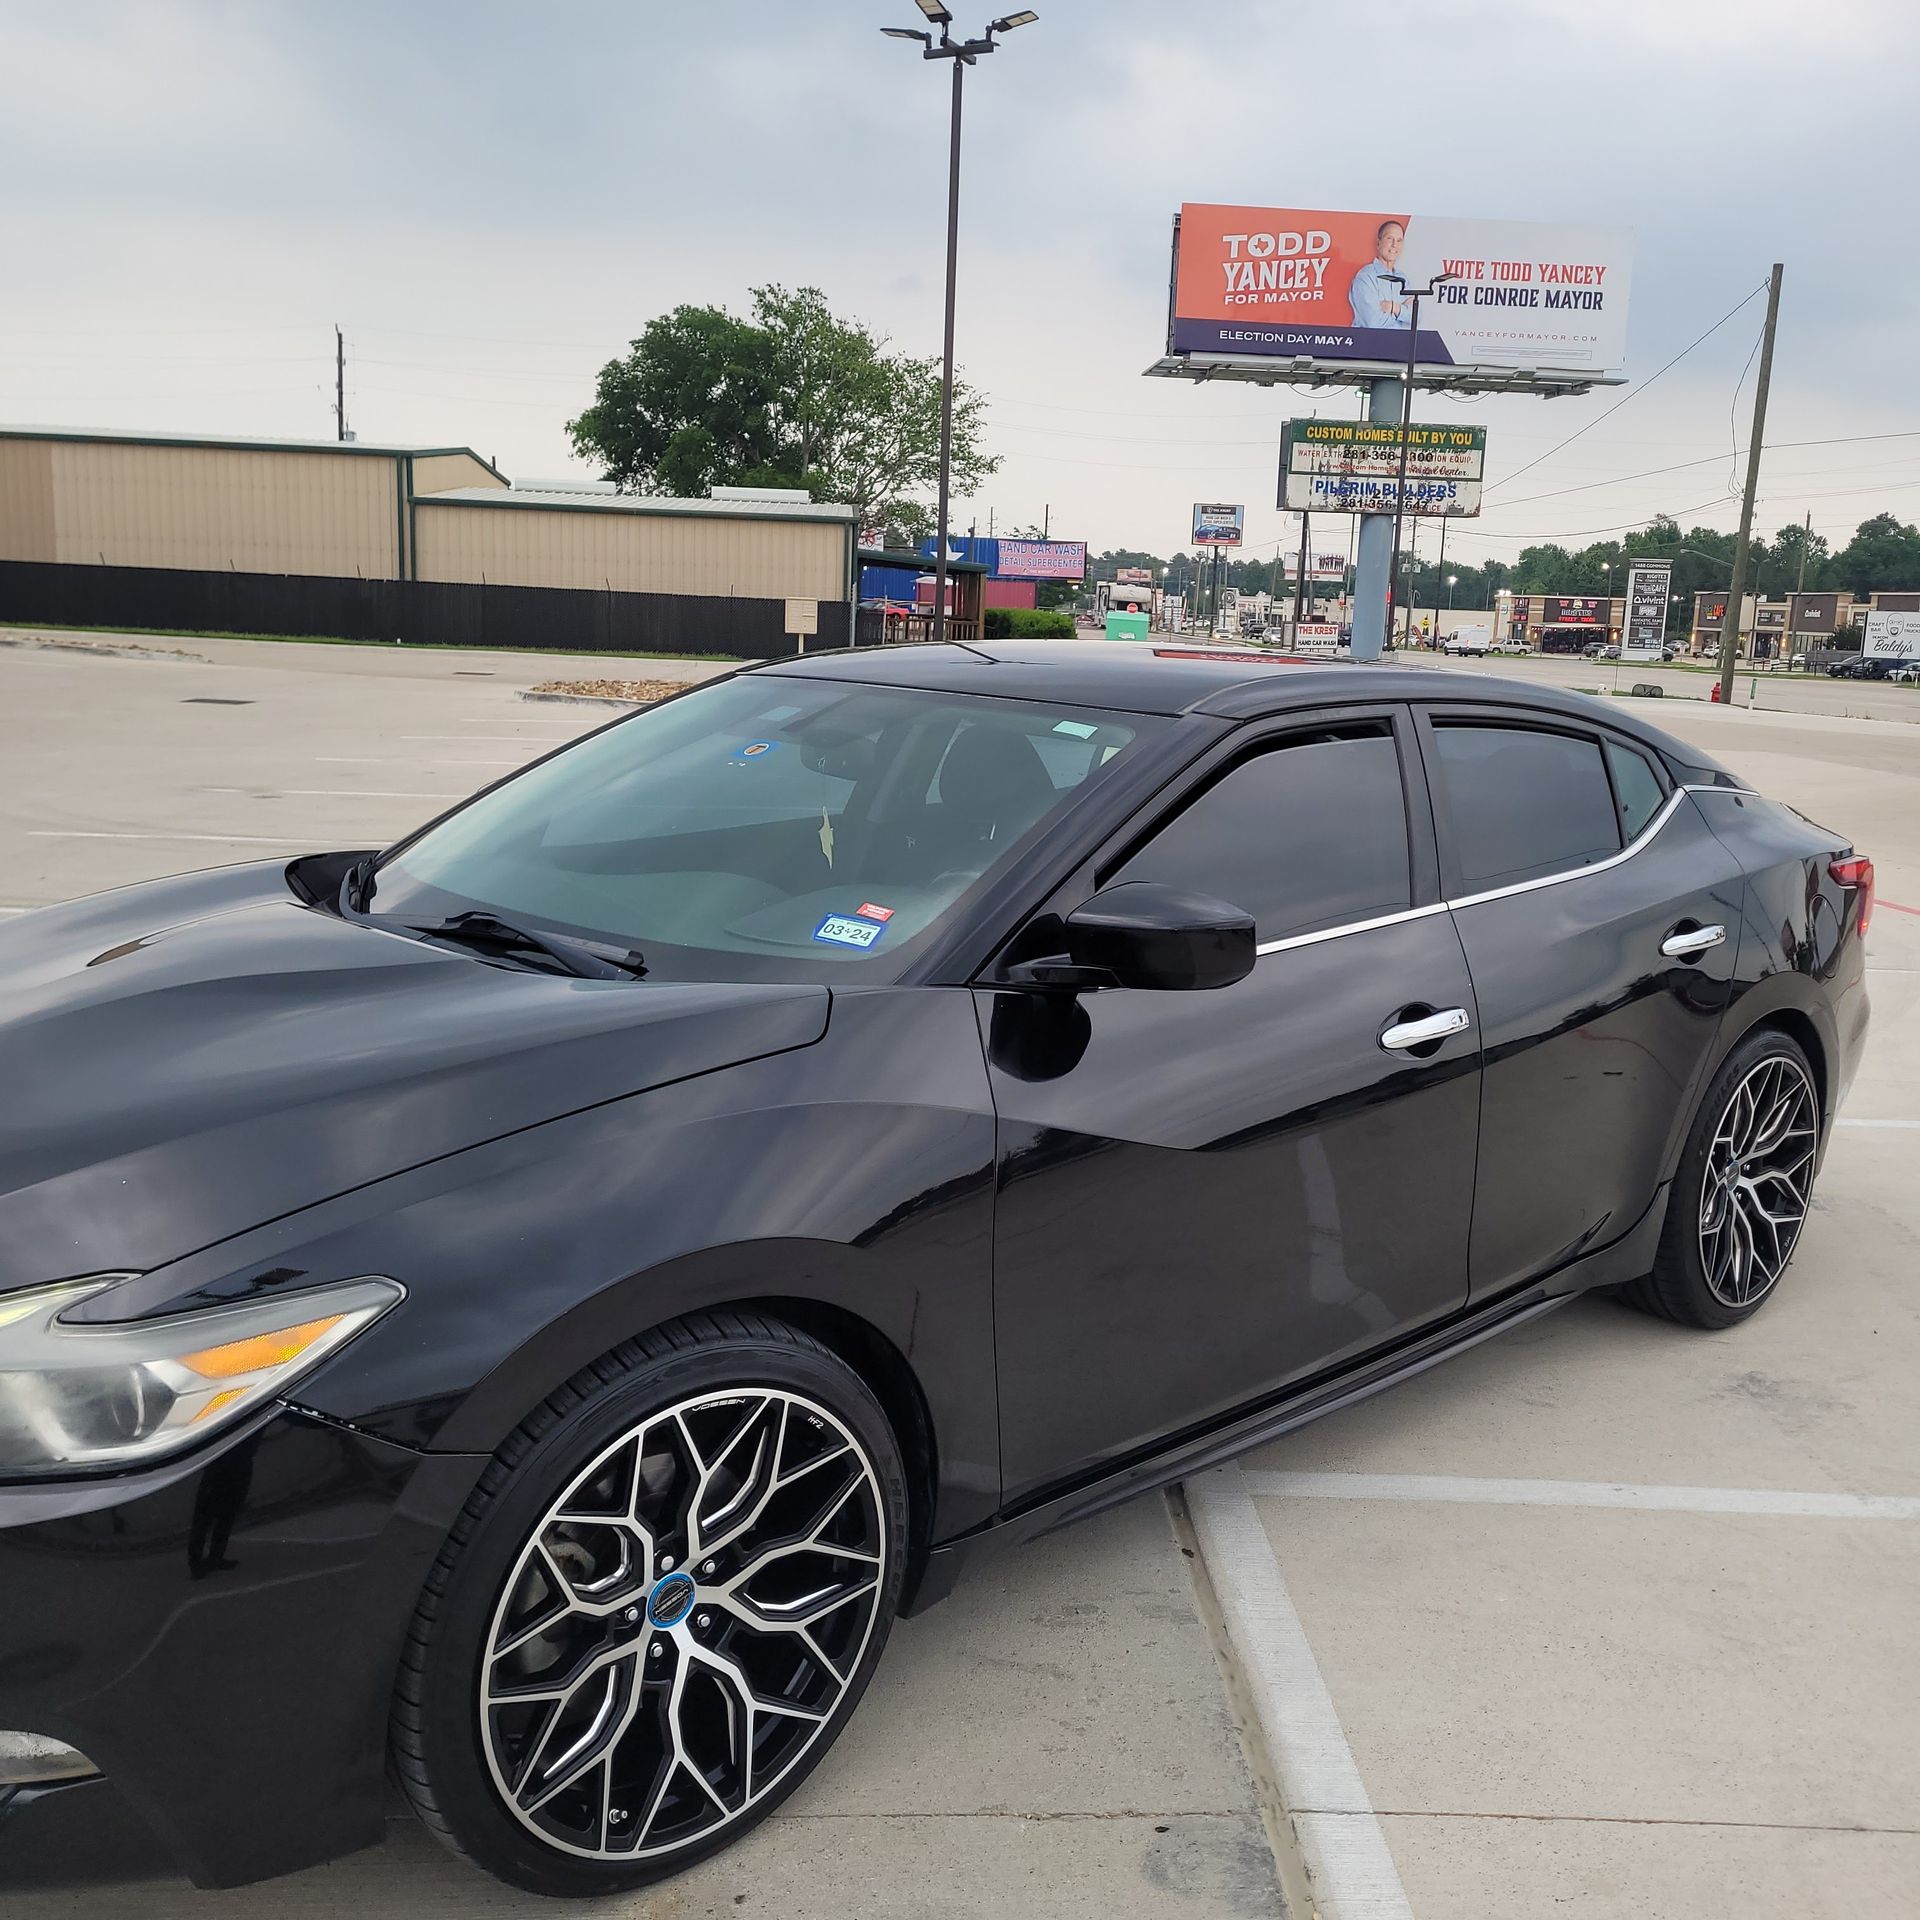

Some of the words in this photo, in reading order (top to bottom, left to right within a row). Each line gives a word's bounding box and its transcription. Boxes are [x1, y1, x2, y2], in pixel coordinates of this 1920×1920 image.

[1222, 230, 1331, 258] TODD
[1222, 258, 1331, 292] YANCEY
[1442, 259, 1485, 280] VOTE
[1491, 261, 1532, 282] TODD
[1538, 264, 1607, 286] YANCEY
[1224, 294, 1259, 305] FOR
[1264, 291, 1324, 303] MAYOR
[1437, 285, 1468, 305] FOR
[1474, 286, 1539, 307] CONROE
[1544, 289, 1603, 310] MAYOR
[1219, 330, 1284, 343] ELECTION
[1287, 333, 1313, 344] DAY
[1314, 335, 1343, 346] MAY
[1344, 337, 1354, 346] 4
[1454, 330, 1598, 342] YANCEYFORMAYOR.COM
[1306, 426, 1353, 440] CUSTOM
[1355, 428, 1394, 442] HOMES
[1431, 431, 1447, 444] BY
[1450, 432, 1473, 446] YOU
[1315, 480, 1377, 497] PILGRIM
[999, 541, 1027, 554] HAND
[1030, 543, 1052, 555] CAR
[1054, 544, 1084, 556] WASH
[999, 556, 1025, 566] DETAIL
[1027, 557, 1084, 568] SUPERCENTER
[1298, 626, 1313, 635] THE
[1314, 626, 1338, 636] KREST
[1873, 639, 1914, 659] Baldy's
[823, 923, 845, 936] 03
[849, 928, 872, 942] 24
[691, 1398, 746, 1412] VOSSEN
